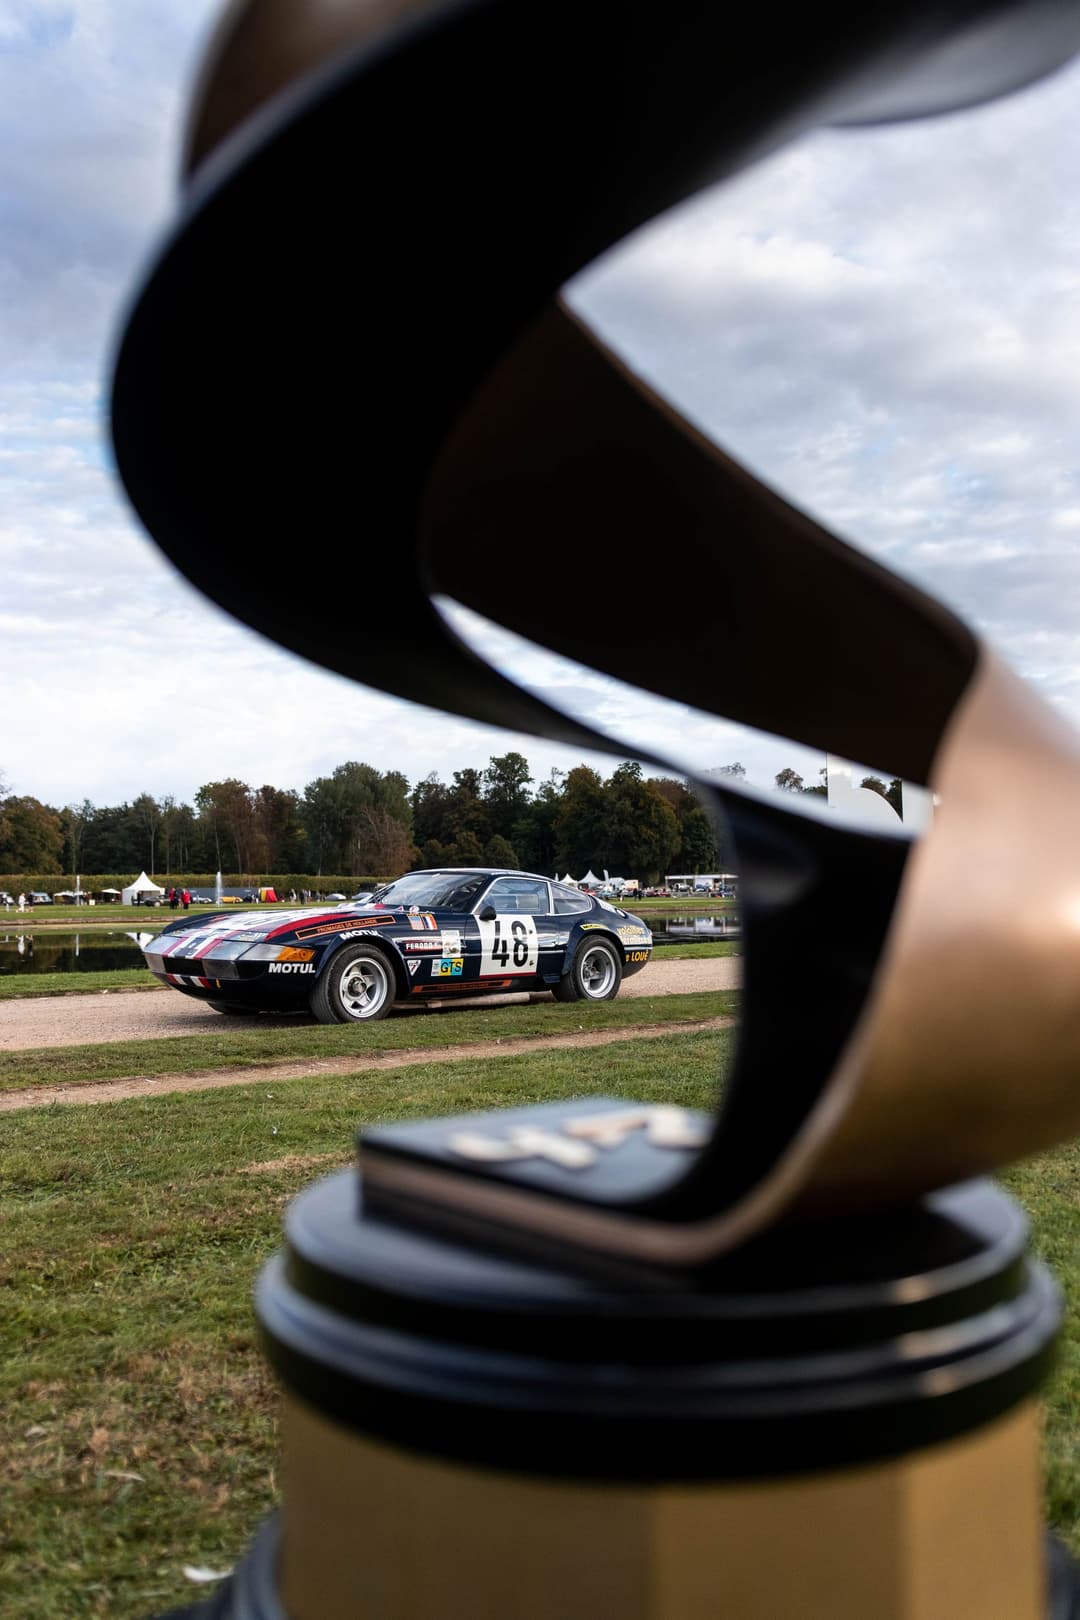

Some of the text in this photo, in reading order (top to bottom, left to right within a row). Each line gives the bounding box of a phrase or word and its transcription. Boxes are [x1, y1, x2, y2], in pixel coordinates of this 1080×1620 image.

[317, 922, 343, 933] FROMAGES
[353, 918, 378, 927] HOLLANDE
[339, 929, 384, 940] MOTUL
[491, 920, 529, 968] 48
[268, 962, 316, 974] MOTUL
[440, 961, 462, 973] GTS
